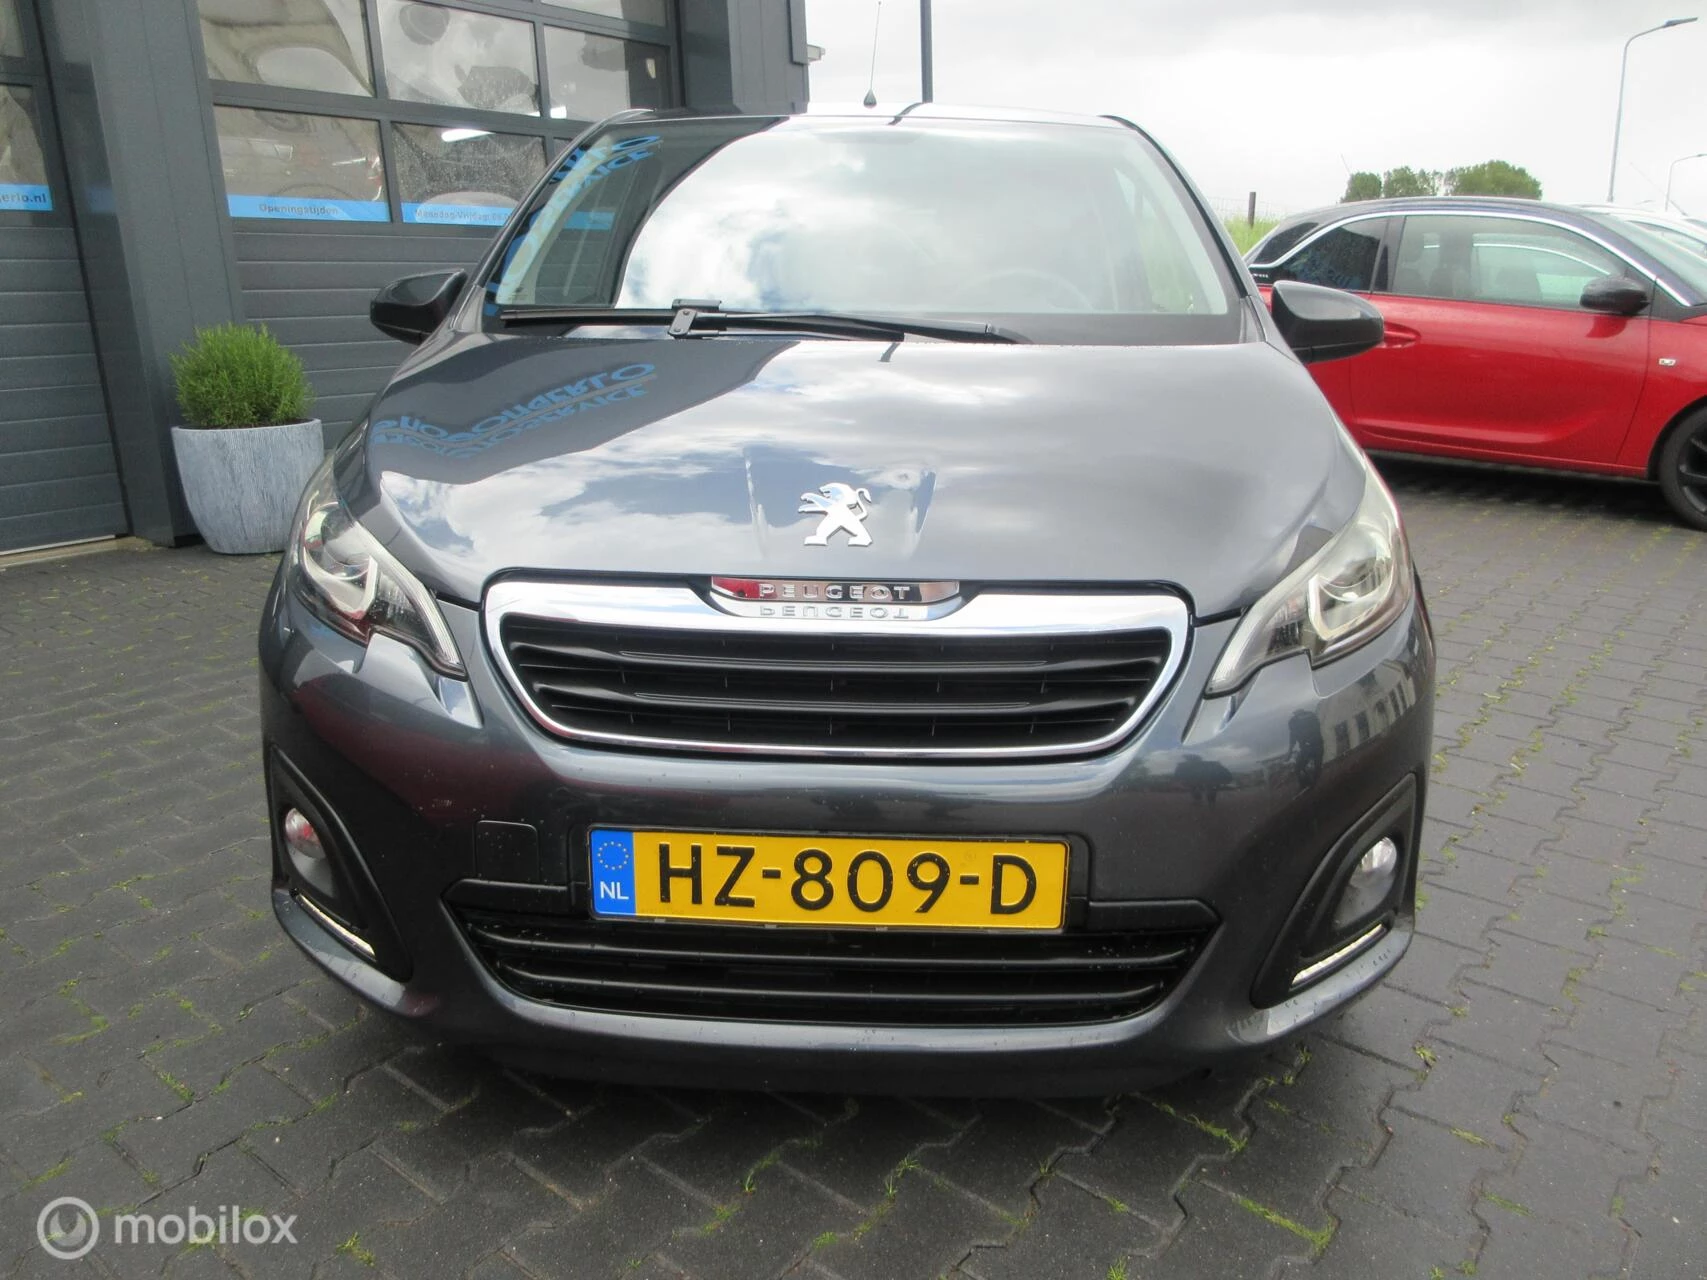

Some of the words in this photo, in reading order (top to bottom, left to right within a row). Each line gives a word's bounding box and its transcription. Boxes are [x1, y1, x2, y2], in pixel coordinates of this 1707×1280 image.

[258, 203, 339, 216] Openingstijden
[758, 583, 910, 600] PEUGEOT
[658, 841, 1037, 914] HZ-809-D
[599, 880, 629, 900] NL
